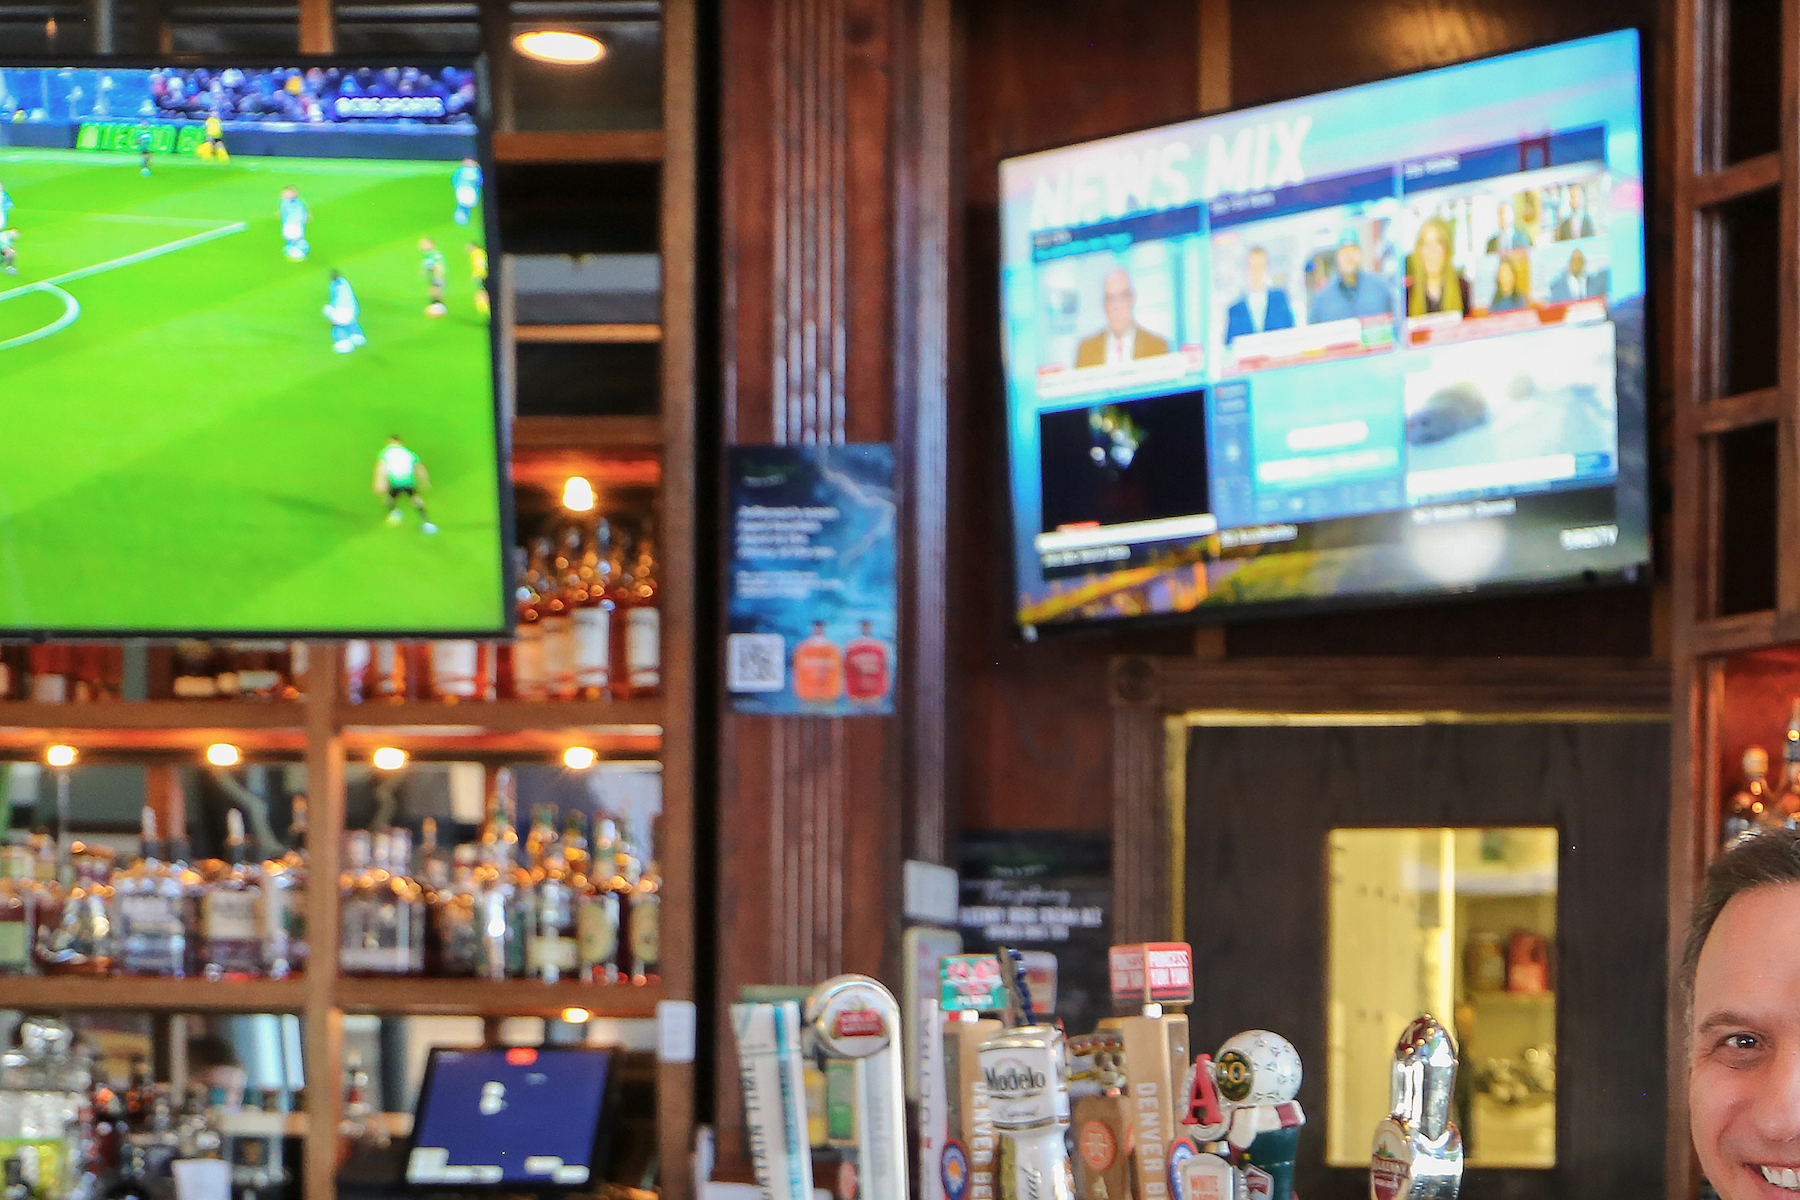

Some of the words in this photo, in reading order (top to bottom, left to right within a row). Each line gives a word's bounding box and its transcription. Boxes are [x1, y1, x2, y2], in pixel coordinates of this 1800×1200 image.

[1029, 142, 1192, 230] NEWS
[1205, 115, 1313, 199] MIX
[984, 1067, 1047, 1092] Modelo
[1182, 1053, 1223, 1125] A
[971, 1082, 994, 1164] DENVER
[1136, 1082, 1164, 1174] DENVER
